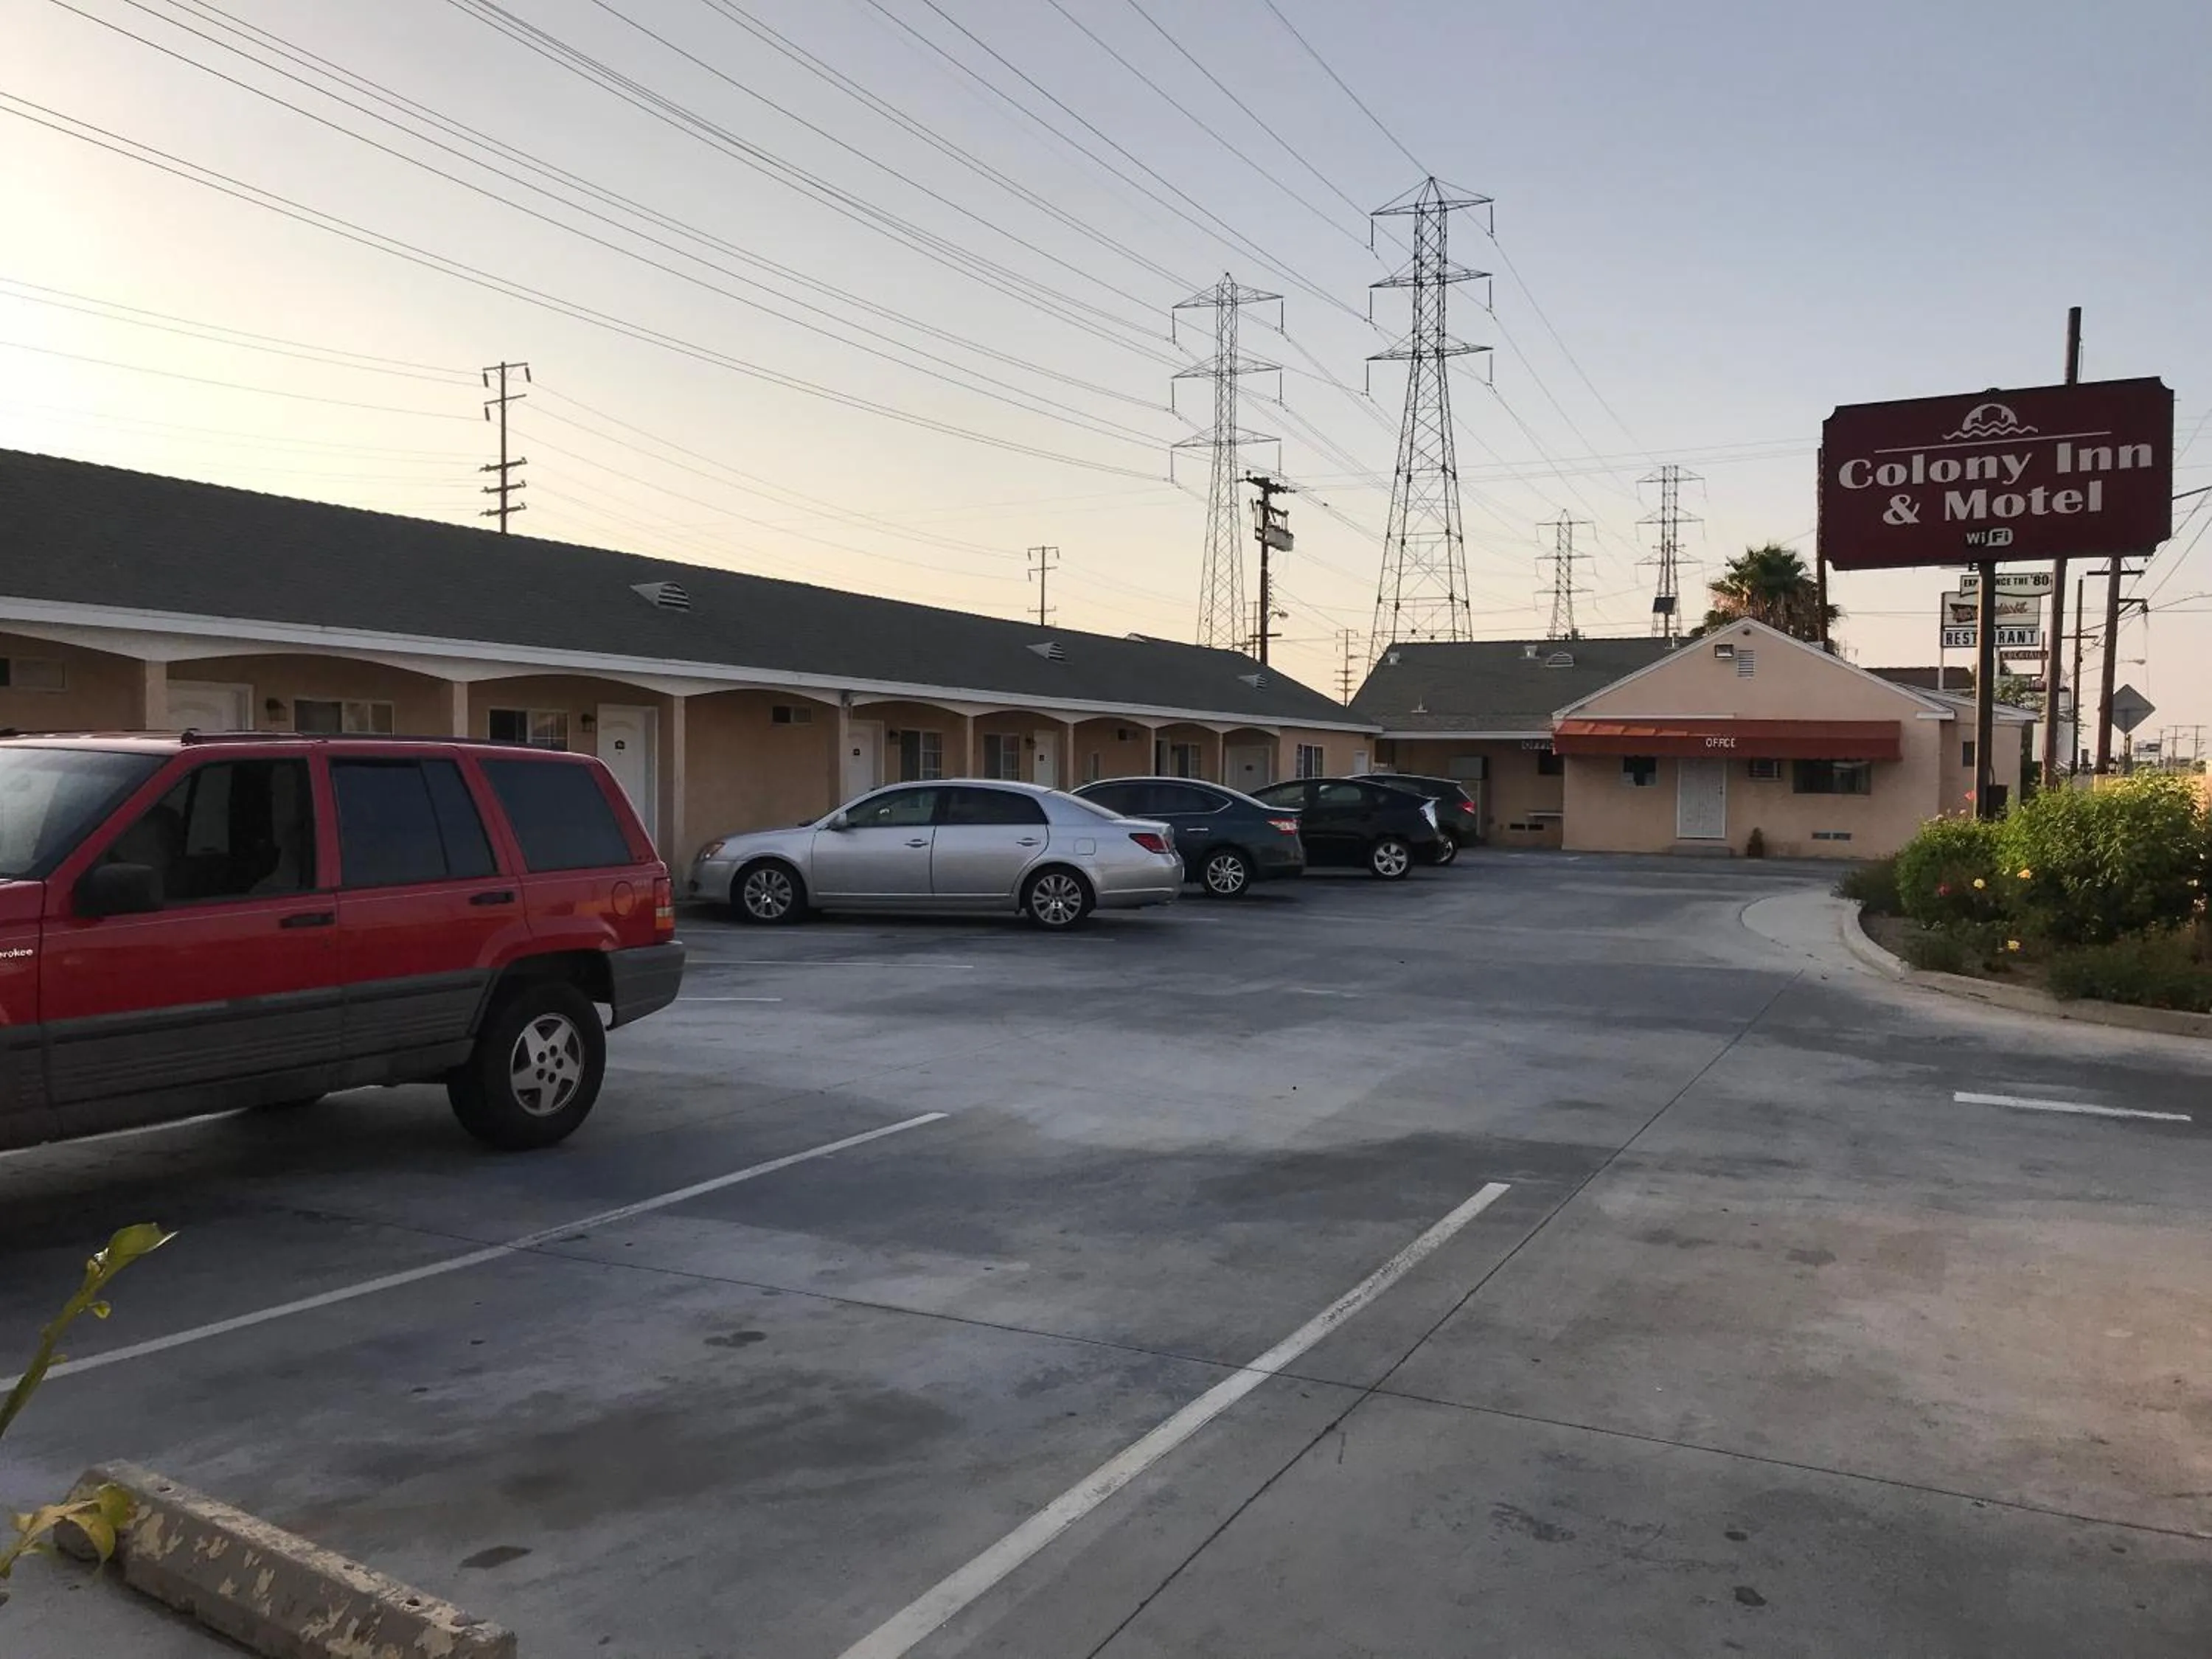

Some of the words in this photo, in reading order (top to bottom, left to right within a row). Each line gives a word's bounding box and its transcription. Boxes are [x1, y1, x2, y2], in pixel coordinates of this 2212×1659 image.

[1838, 453, 2032, 489] Colony
[2056, 442, 2153, 473] Inn
[1882, 494, 1920, 525] &
[1944, 481, 2102, 521] Motel
[1946, 631, 2035, 645] RESTRANT
